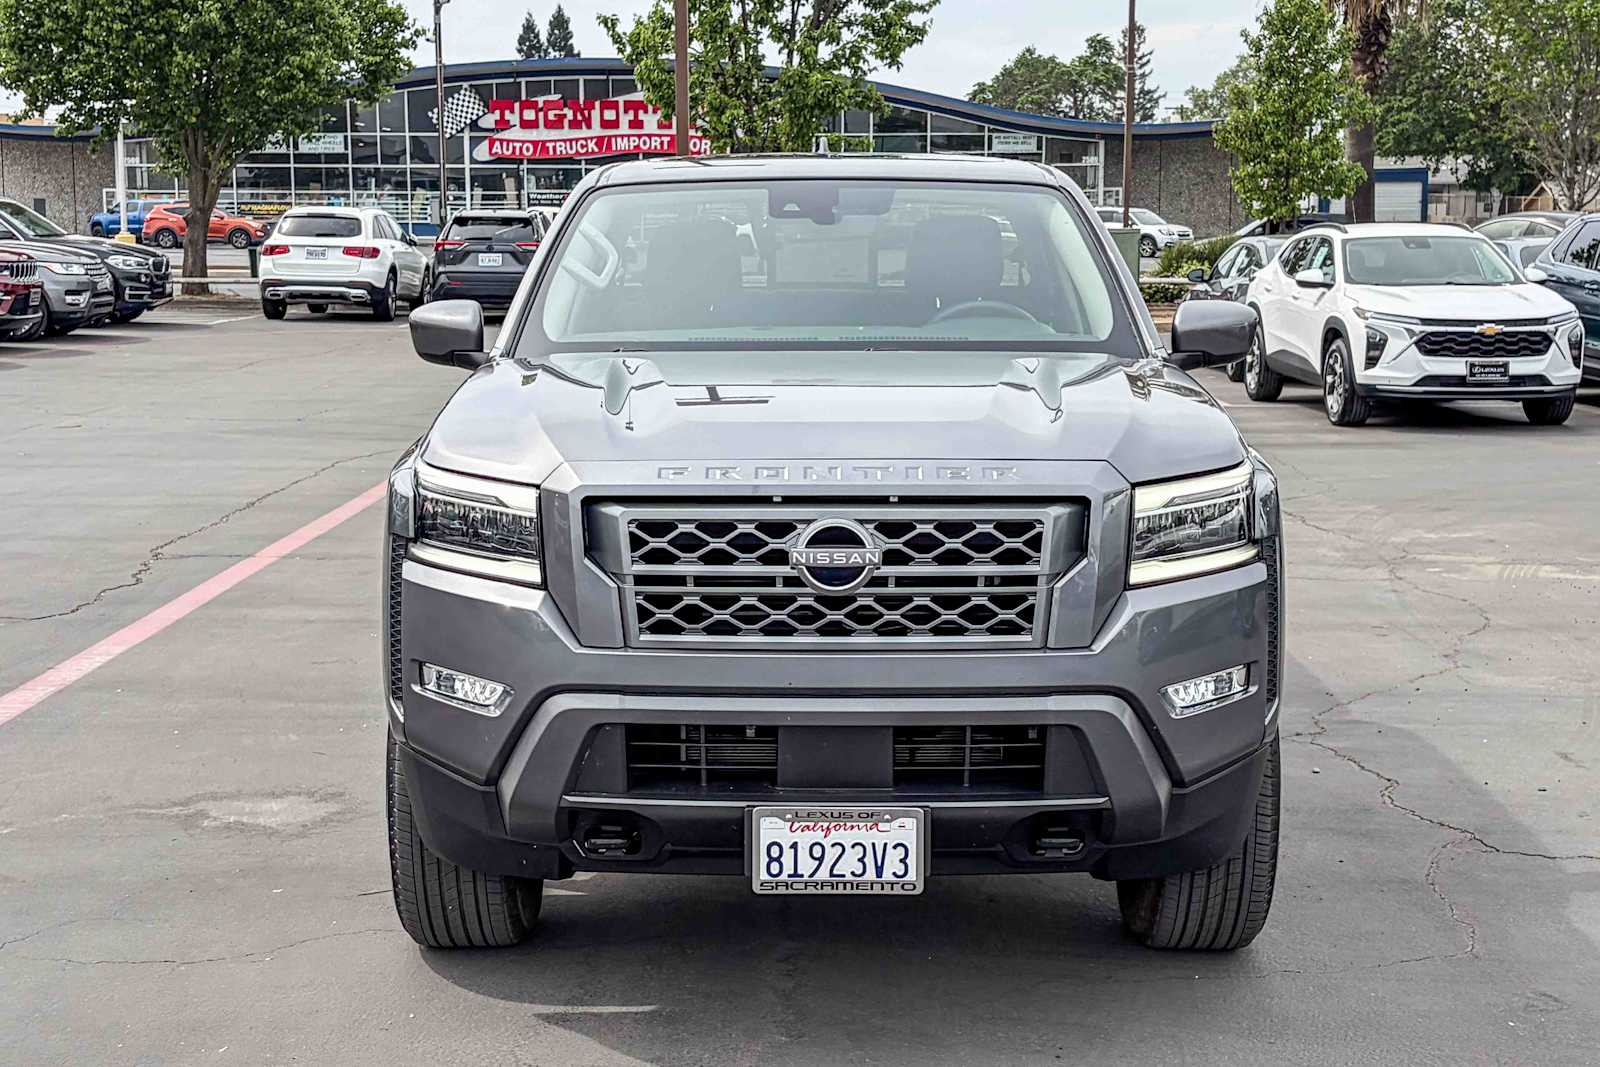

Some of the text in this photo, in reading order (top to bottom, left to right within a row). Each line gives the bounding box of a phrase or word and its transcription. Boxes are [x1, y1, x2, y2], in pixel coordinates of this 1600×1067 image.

[491, 141, 534, 155] AUTO
[546, 138, 599, 156] TRUCK
[611, 136, 671, 151] IMPORT
[657, 466, 1022, 481] FRONTIER
[792, 551, 880, 564] NISSAN
[795, 811, 881, 819] LEXUS OF
[789, 821, 891, 838] California
[765, 841, 910, 879] 81923V3
[759, 881, 917, 891] SACRAMENTO
